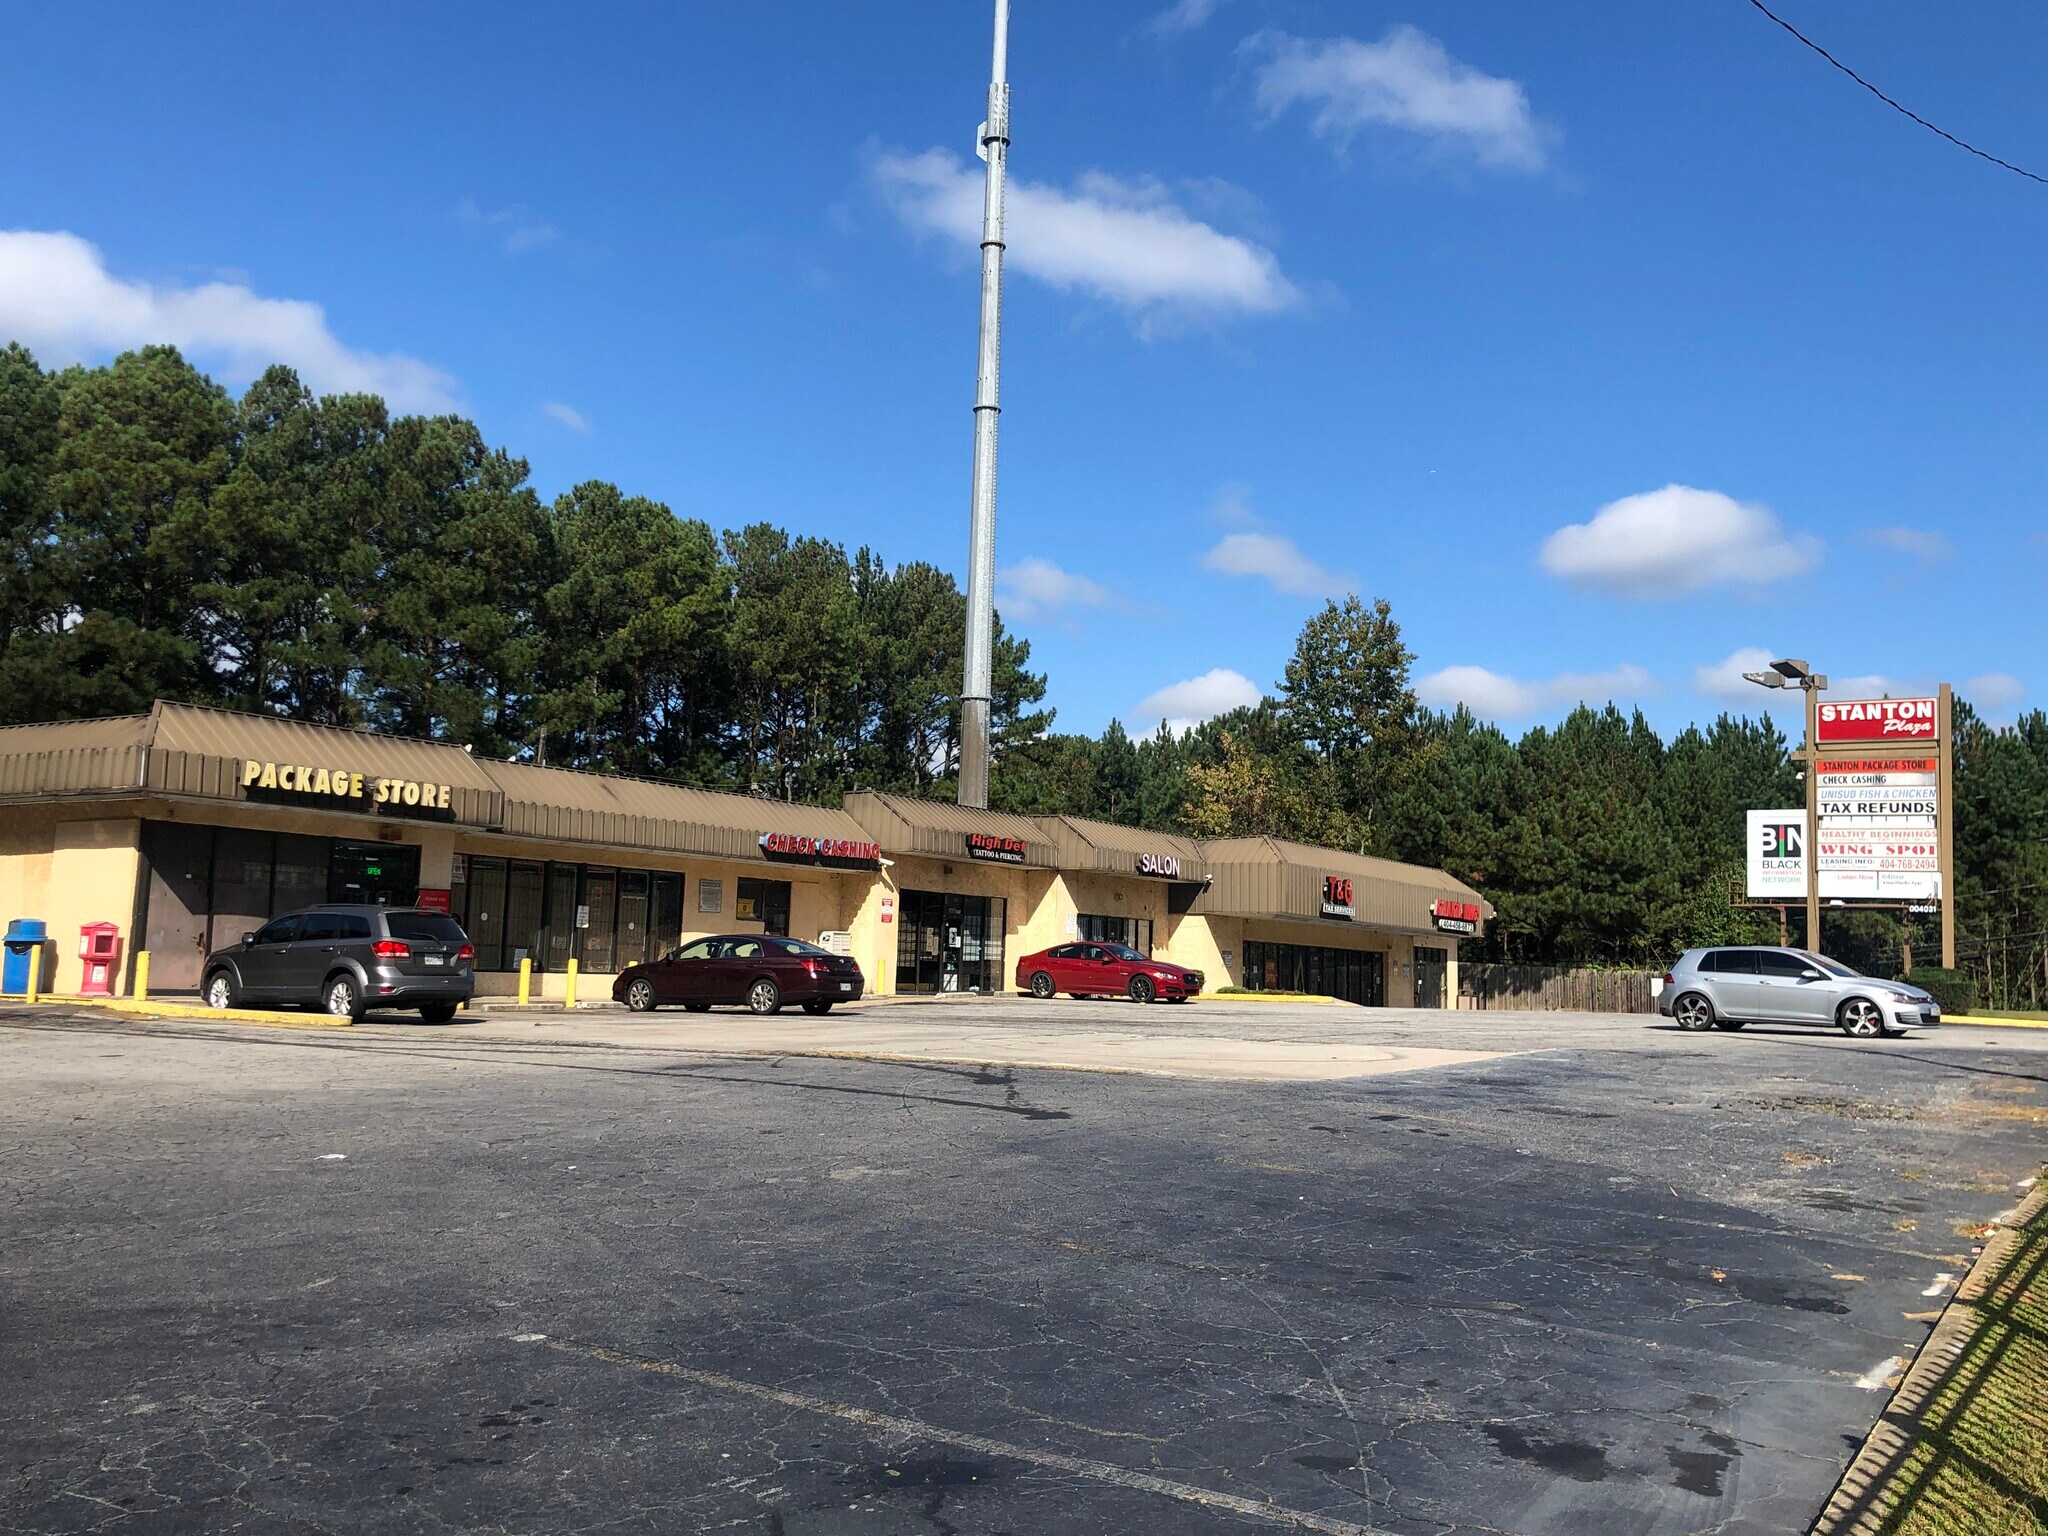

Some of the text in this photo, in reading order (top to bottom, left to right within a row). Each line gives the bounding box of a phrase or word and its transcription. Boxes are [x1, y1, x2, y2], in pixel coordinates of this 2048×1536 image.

[1821, 701, 1933, 722] STANTON
[1883, 718, 1932, 735] Plaza
[1822, 760, 1928, 771] STANTON PACKAGE STORE
[243, 759, 451, 809] PACKAGE STORE
[1822, 774, 1887, 785] CHECK CASHING
[1821, 788, 1937, 799] UNISUB FISH & CHICKEN
[1820, 801, 1936, 814] TAX REFUNDS
[1821, 830, 1938, 838] HEALTHY BEGINNINGS
[765, 832, 881, 860] CHECK CASHING
[971, 833, 1028, 852] High Def
[974, 849, 995, 858] TATTOO
[1000, 852, 1022, 861] PIERCING
[1820, 844, 1938, 855] WING SPOT
[1142, 853, 1180, 876] SALON
[1762, 860, 1802, 869] BLACK
[1879, 859, 1936, 869] 404-768-2494
[367, 867, 382, 875] OPEN
